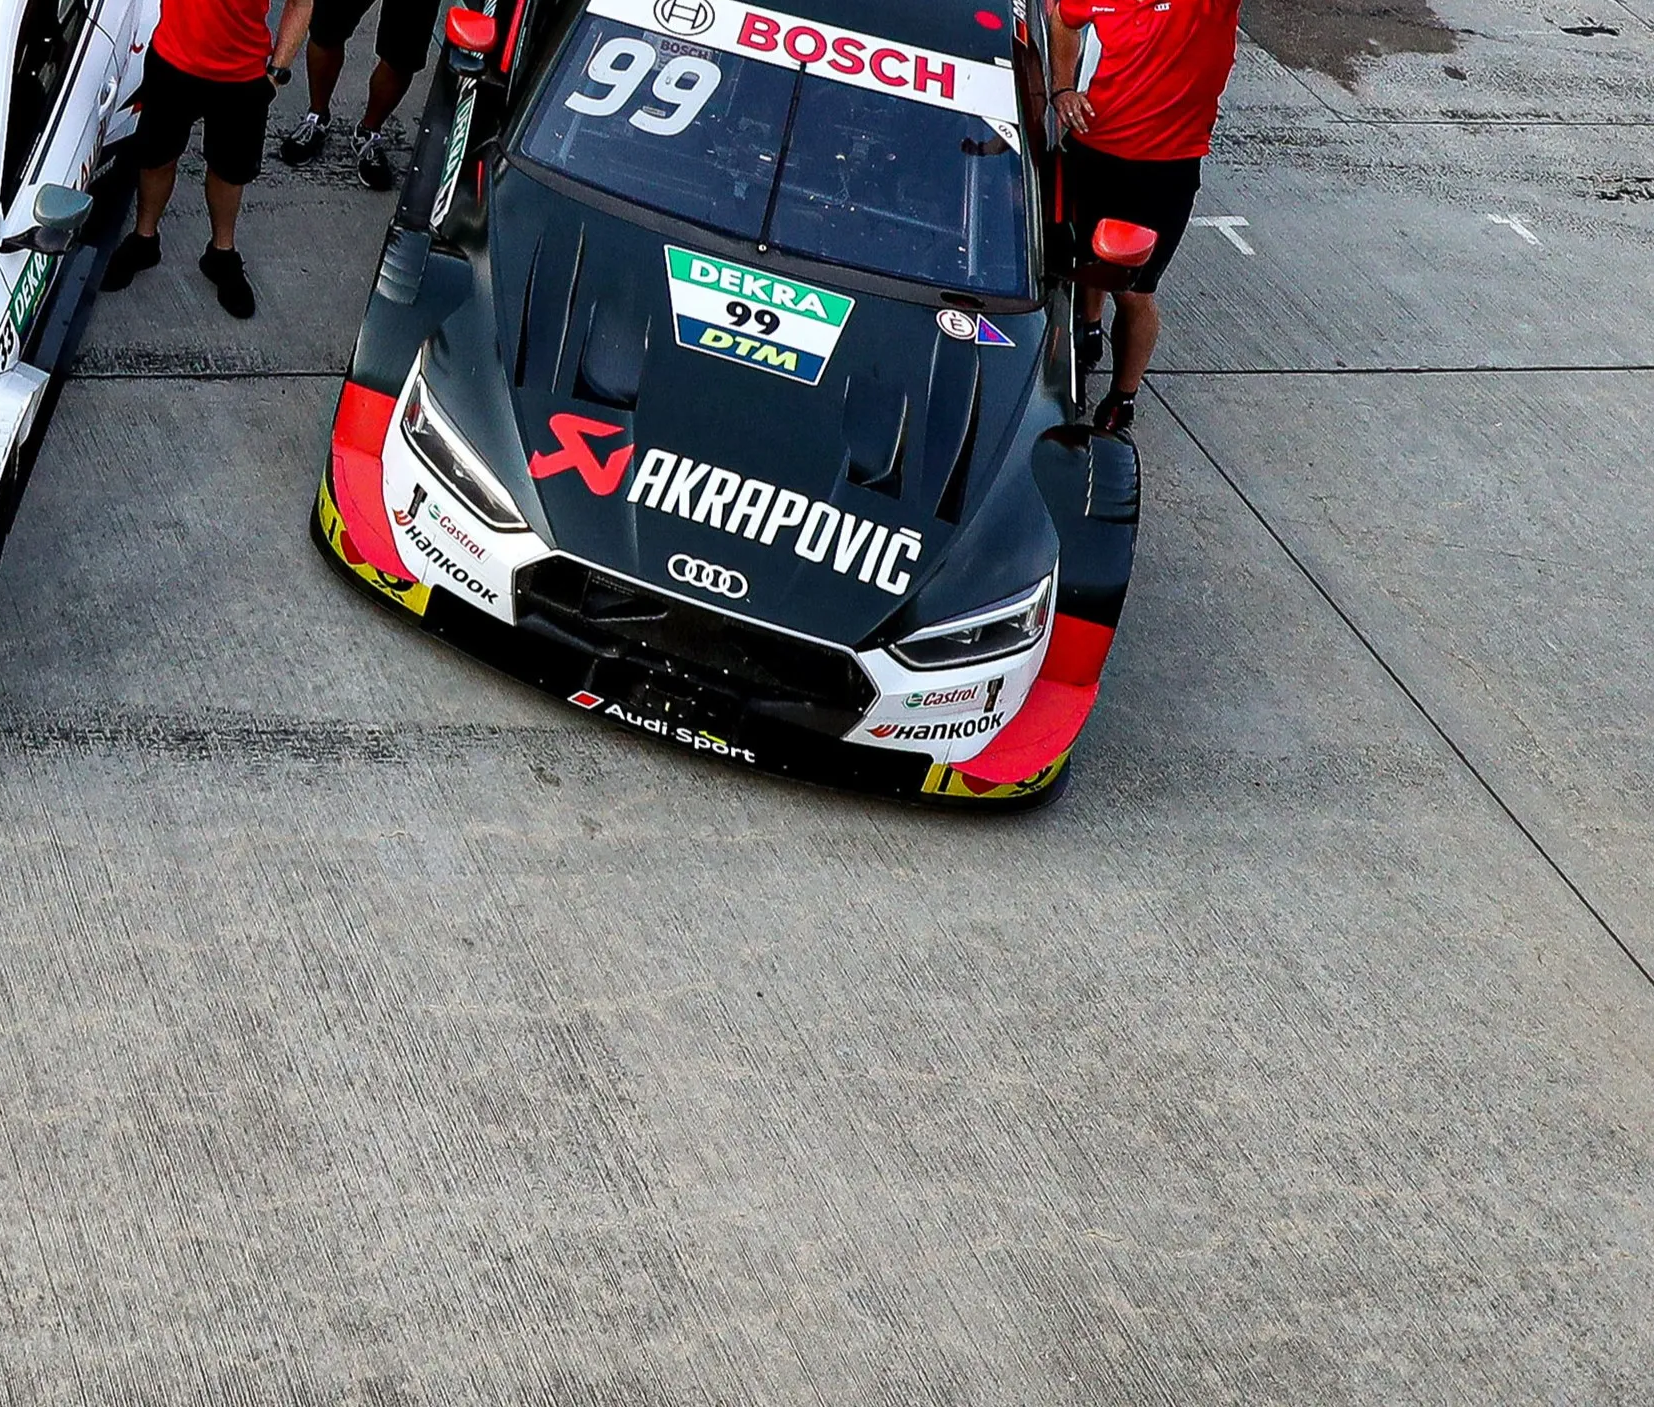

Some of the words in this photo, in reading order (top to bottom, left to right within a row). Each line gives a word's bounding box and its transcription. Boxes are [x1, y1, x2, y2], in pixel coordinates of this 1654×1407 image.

[564, 37, 722, 137] 99
[735, 11, 956, 101] BOSCH
[11, 252, 54, 325] DEKR
[689, 257, 831, 319] DEKRA
[725, 299, 781, 337] 99
[699, 326, 800, 373] DTM
[438, 510, 487, 561] Castrol
[921, 685, 979, 709] Castrol
[603, 702, 669, 737] Audi
[672, 726, 758, 765] Sport
